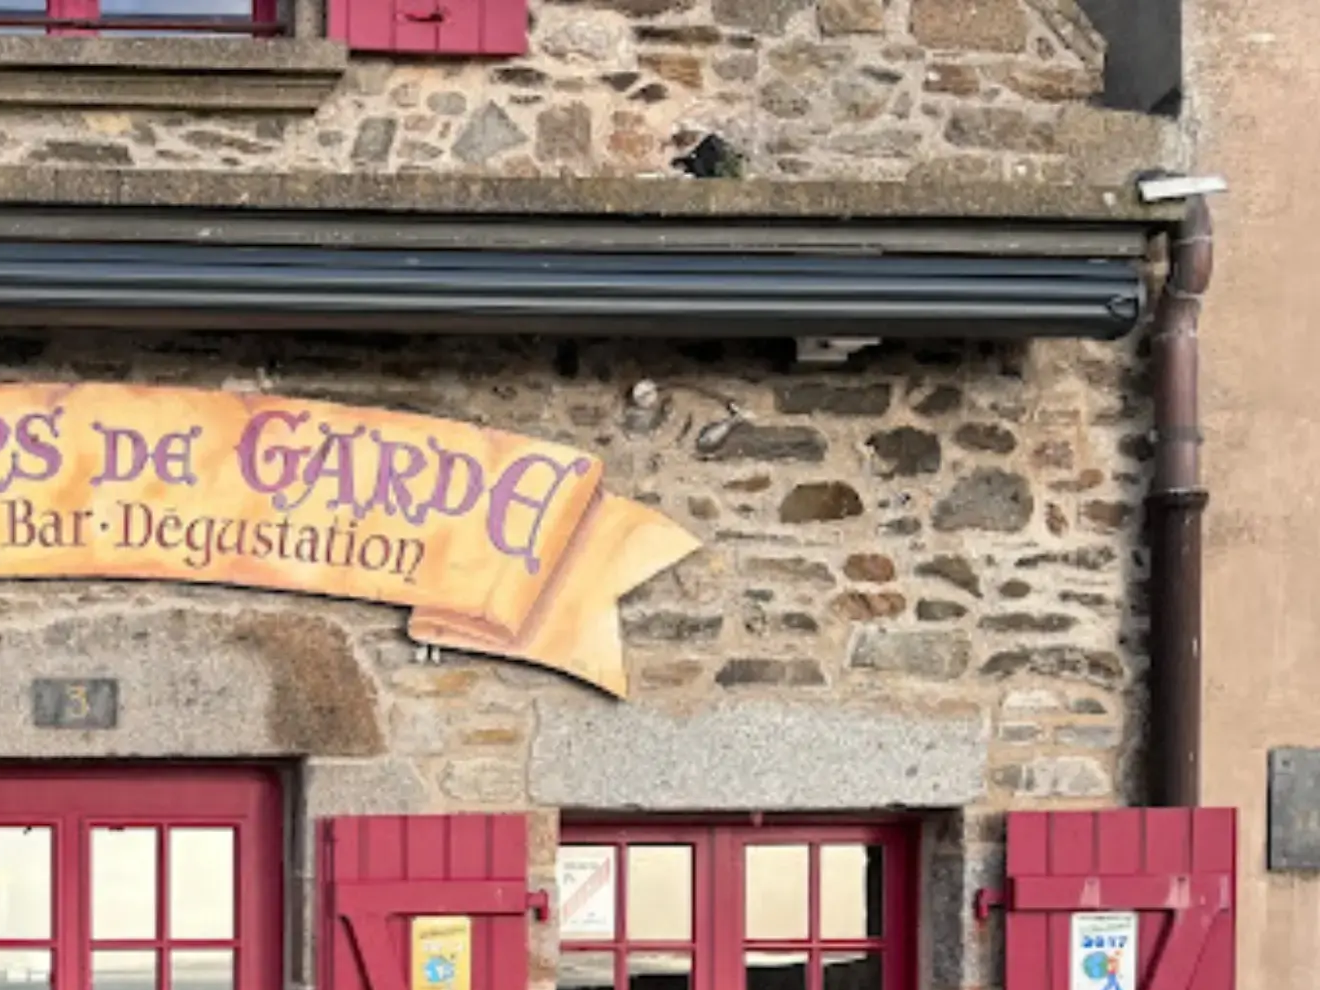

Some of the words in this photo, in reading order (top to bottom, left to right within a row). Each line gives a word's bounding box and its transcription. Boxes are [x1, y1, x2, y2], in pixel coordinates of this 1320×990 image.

[1, 499, 94, 549] Bar
[90, 421, 203, 487] DE
[233, 410, 591, 575] GARDE
